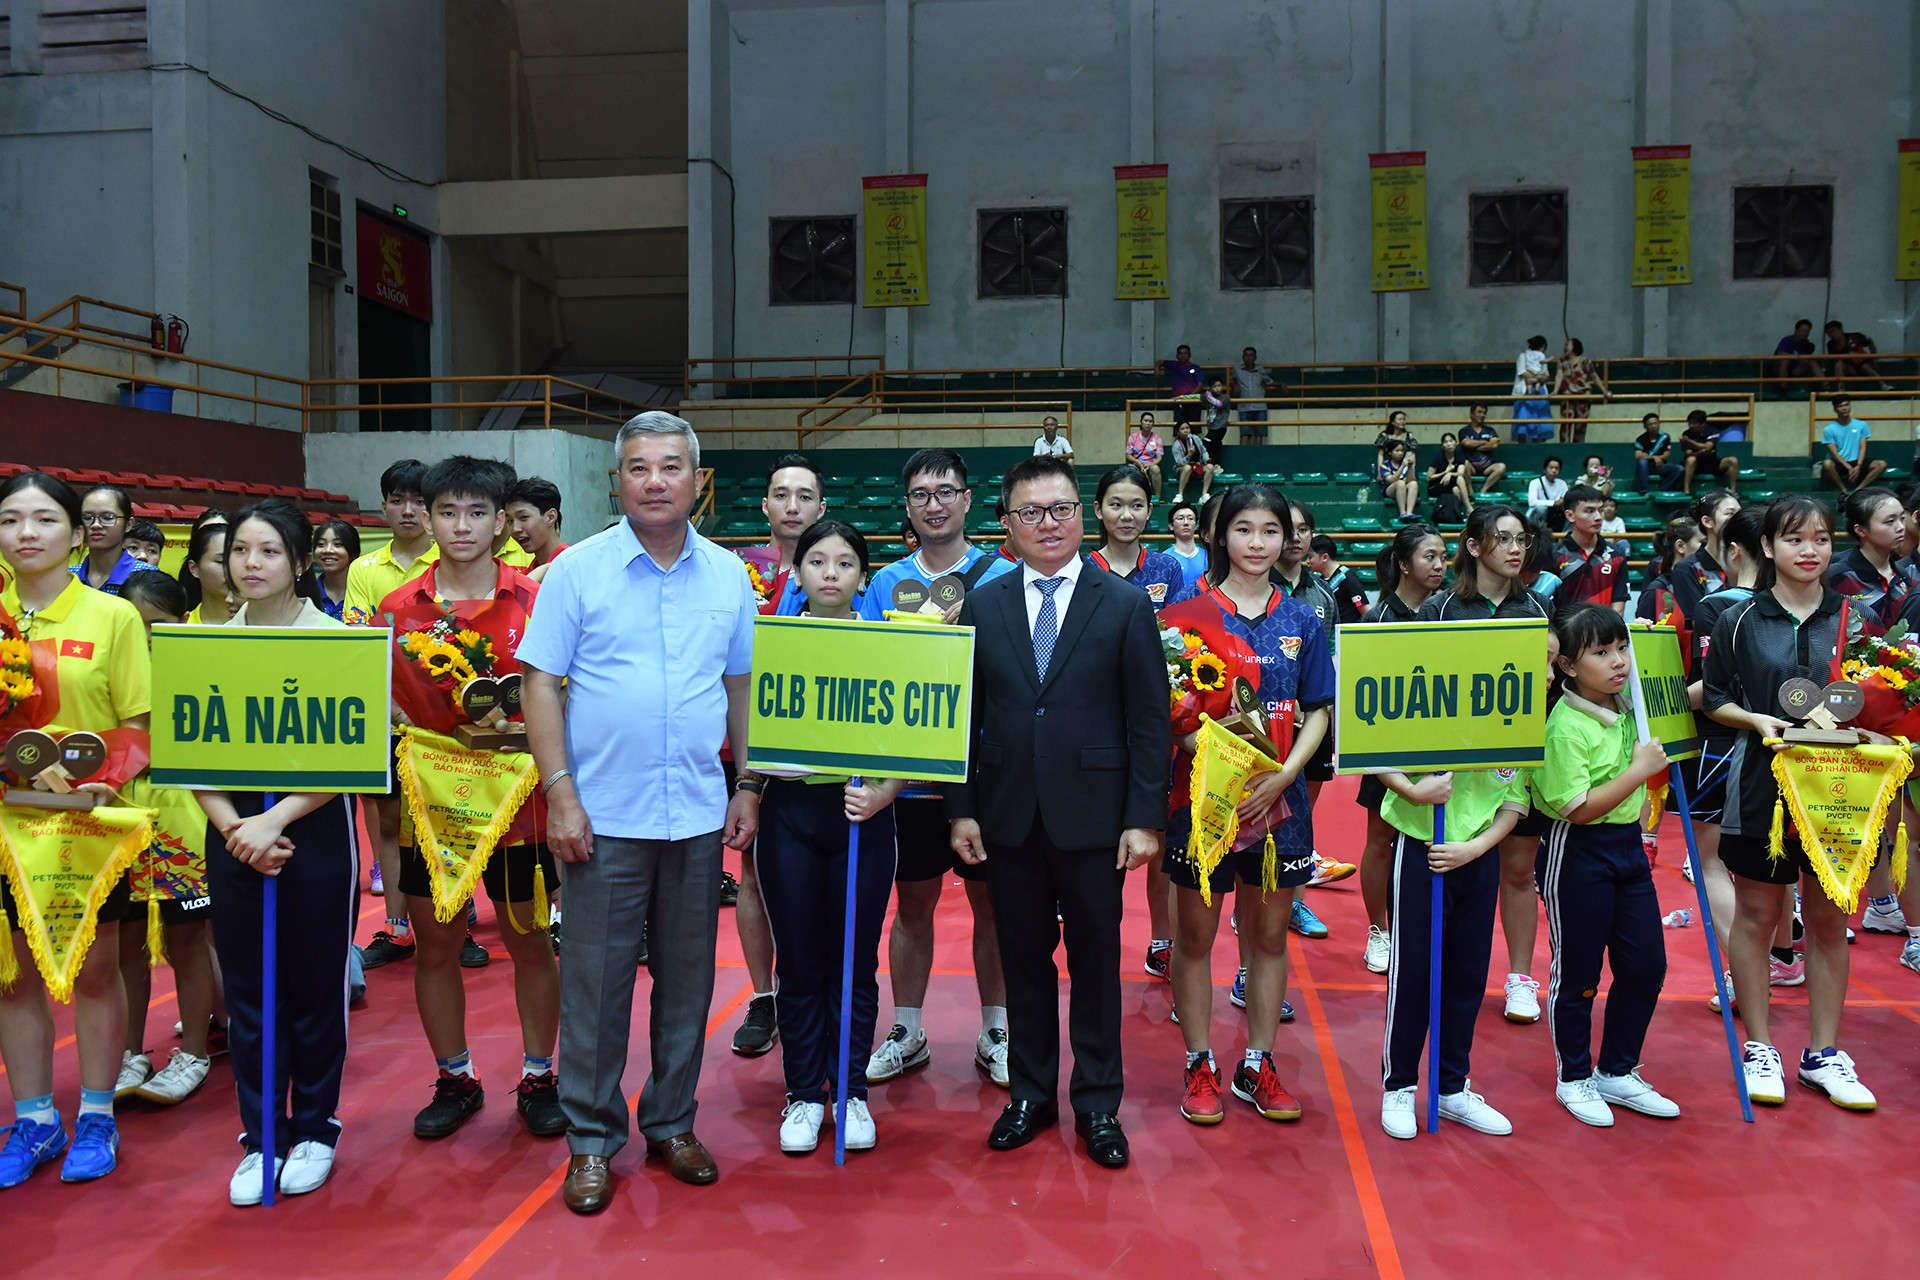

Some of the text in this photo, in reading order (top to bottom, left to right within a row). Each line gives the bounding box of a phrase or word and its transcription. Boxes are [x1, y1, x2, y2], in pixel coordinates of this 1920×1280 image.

[376, 282, 408, 307] SAIGON
[758, 672, 962, 729] CLB TIMES CITY
[1355, 662, 1533, 726] QUÂN ĐỘI
[172, 678, 366, 745] ĐÀ NẴNG
[422, 752, 449, 763] BÓNG
[452, 756, 471, 766] BÀN
[472, 757, 498, 769] QUỐC
[1796, 756, 1817, 764] BÓNG
[1819, 756, 1839, 764] BÀN
[1842, 756, 1867, 766] QUỐC
[434, 762, 502, 778] BÁO NHÂN DÂN
[1805, 764, 1870, 774] BÁO NHÂN DÂN
[429, 804, 492, 819] PETROVIETNAM
[1808, 804, 1870, 812] PETROVIETNAM
[446, 814, 472, 824] PVCFC
[1826, 812, 1852, 820] PVCFC
